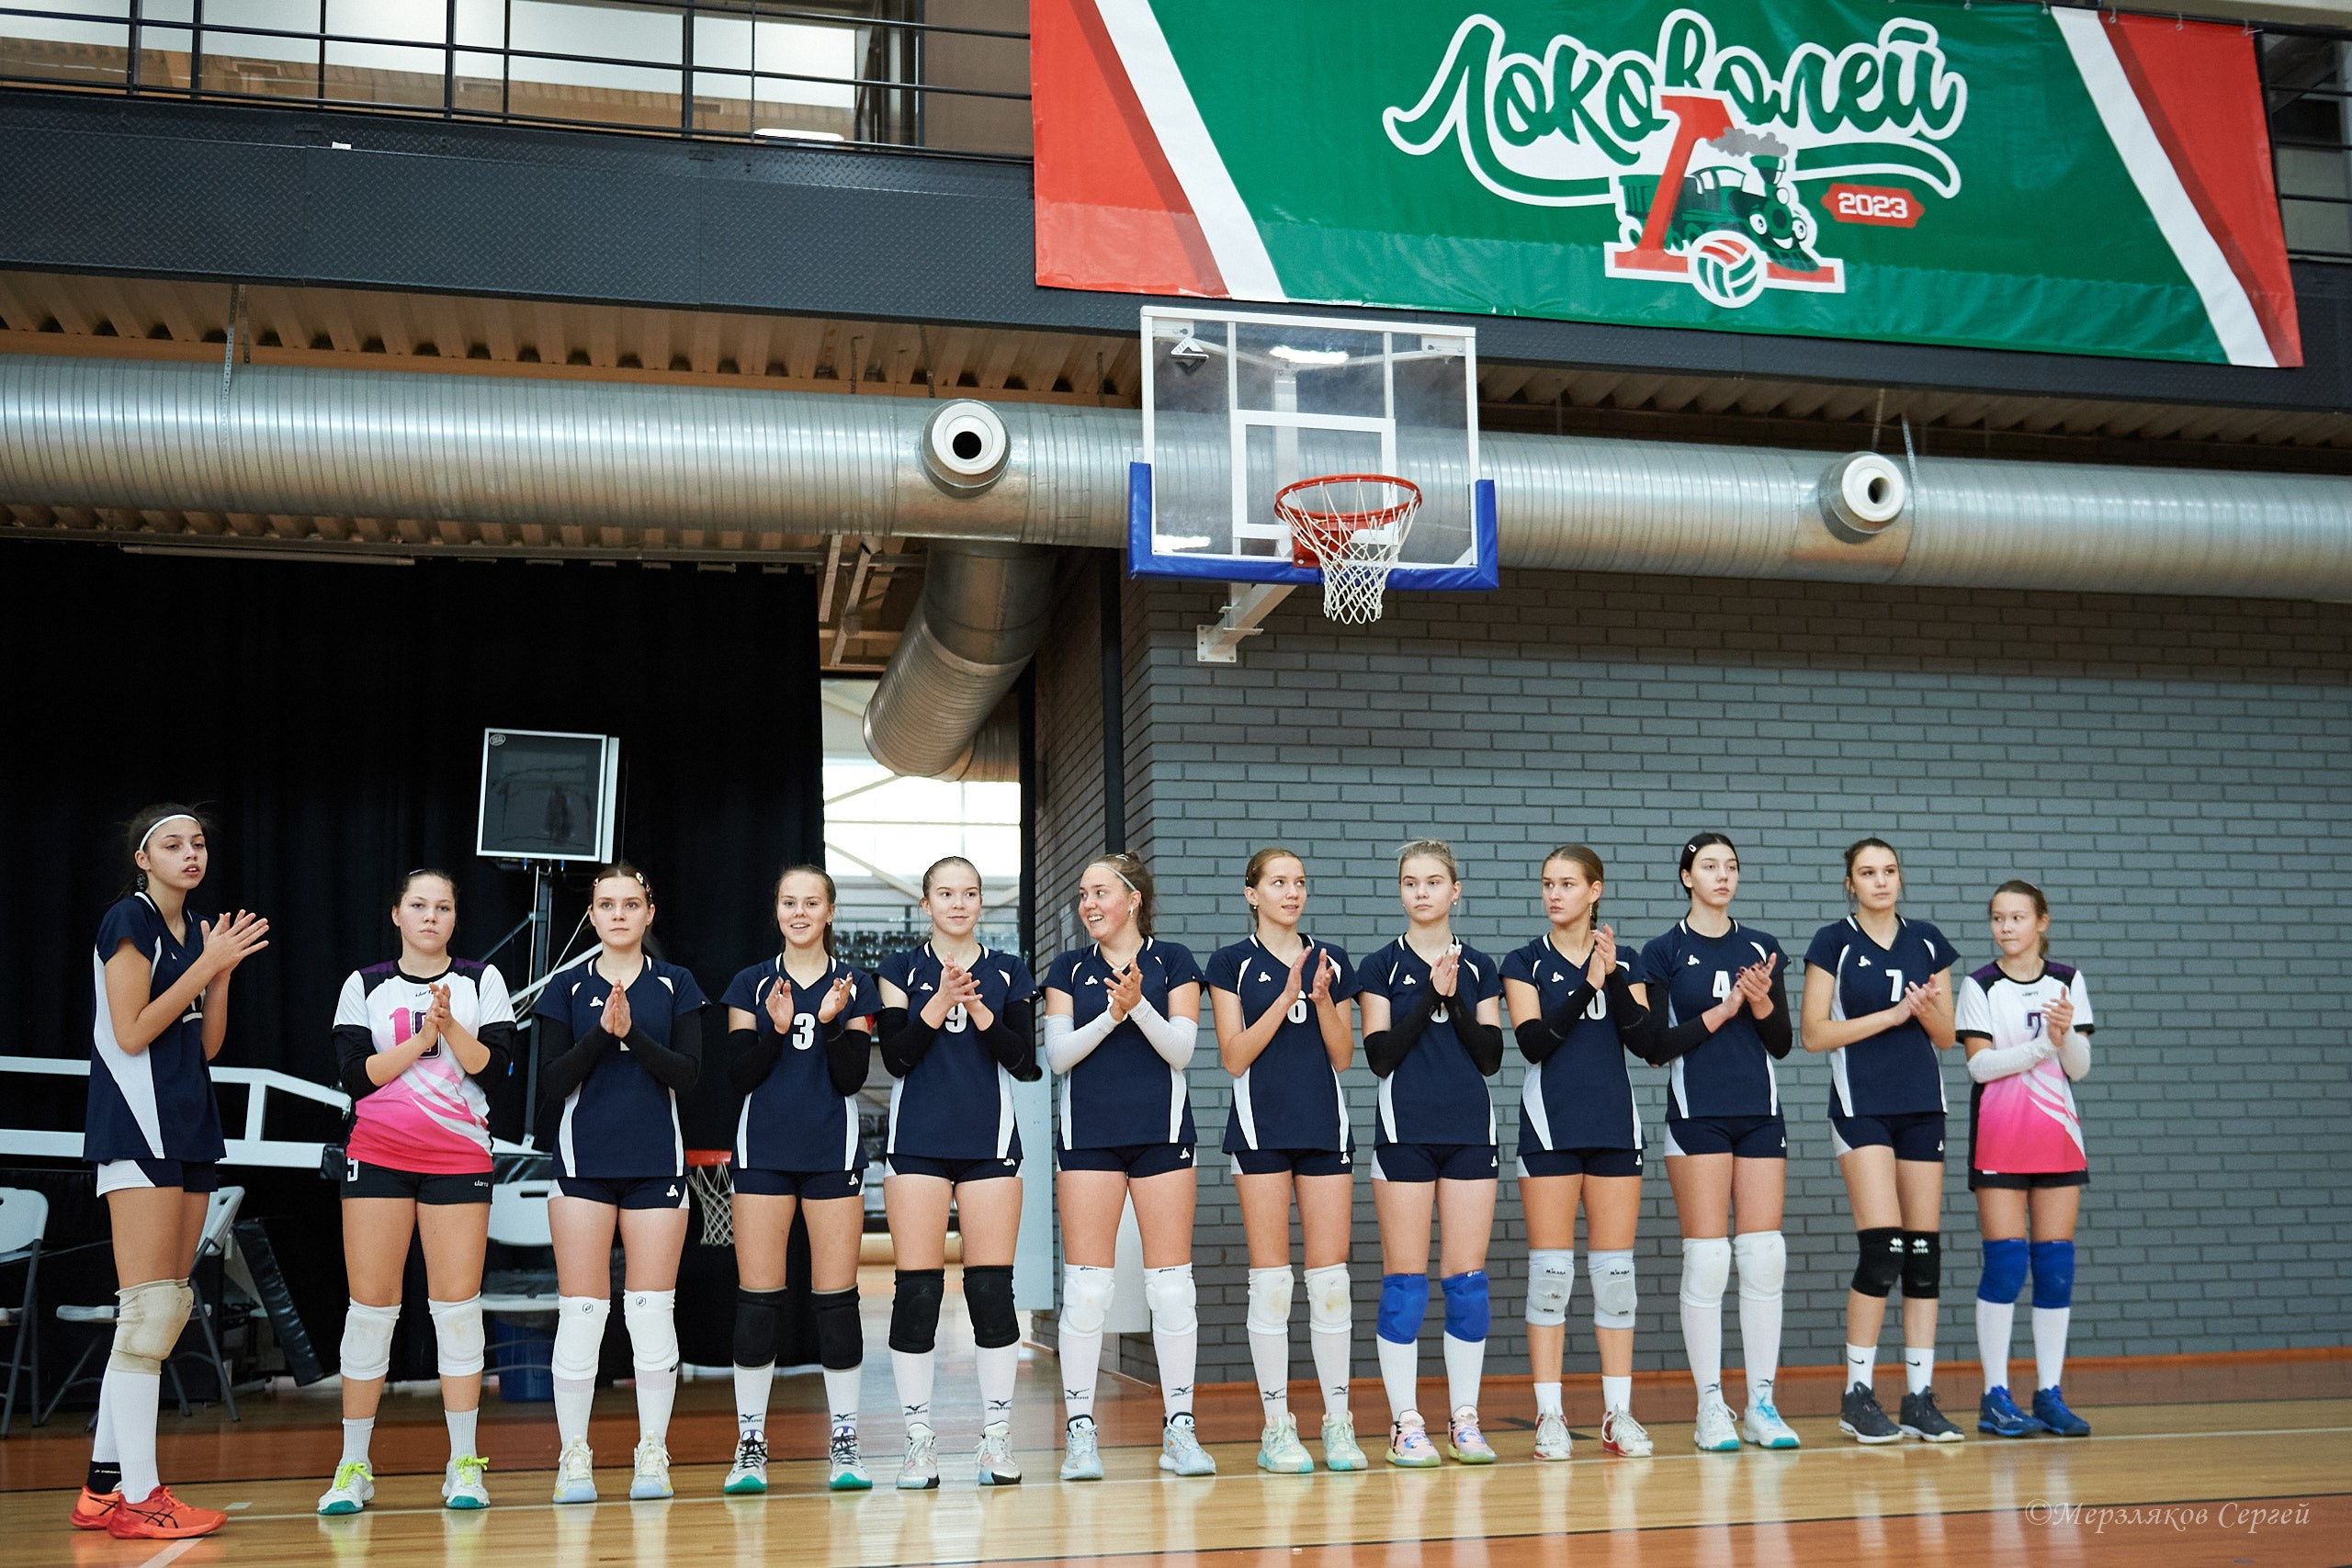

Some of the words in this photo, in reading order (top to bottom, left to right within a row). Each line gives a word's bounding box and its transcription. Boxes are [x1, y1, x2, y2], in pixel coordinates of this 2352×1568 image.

[1838, 191, 1909, 220] 2023
[1712, 970, 1731, 1003] 4
[1884, 968, 1903, 1002] 7
[944, 1002, 967, 1033] 9
[1287, 989, 1307, 1024] 6
[792, 1012, 816, 1051] 3
